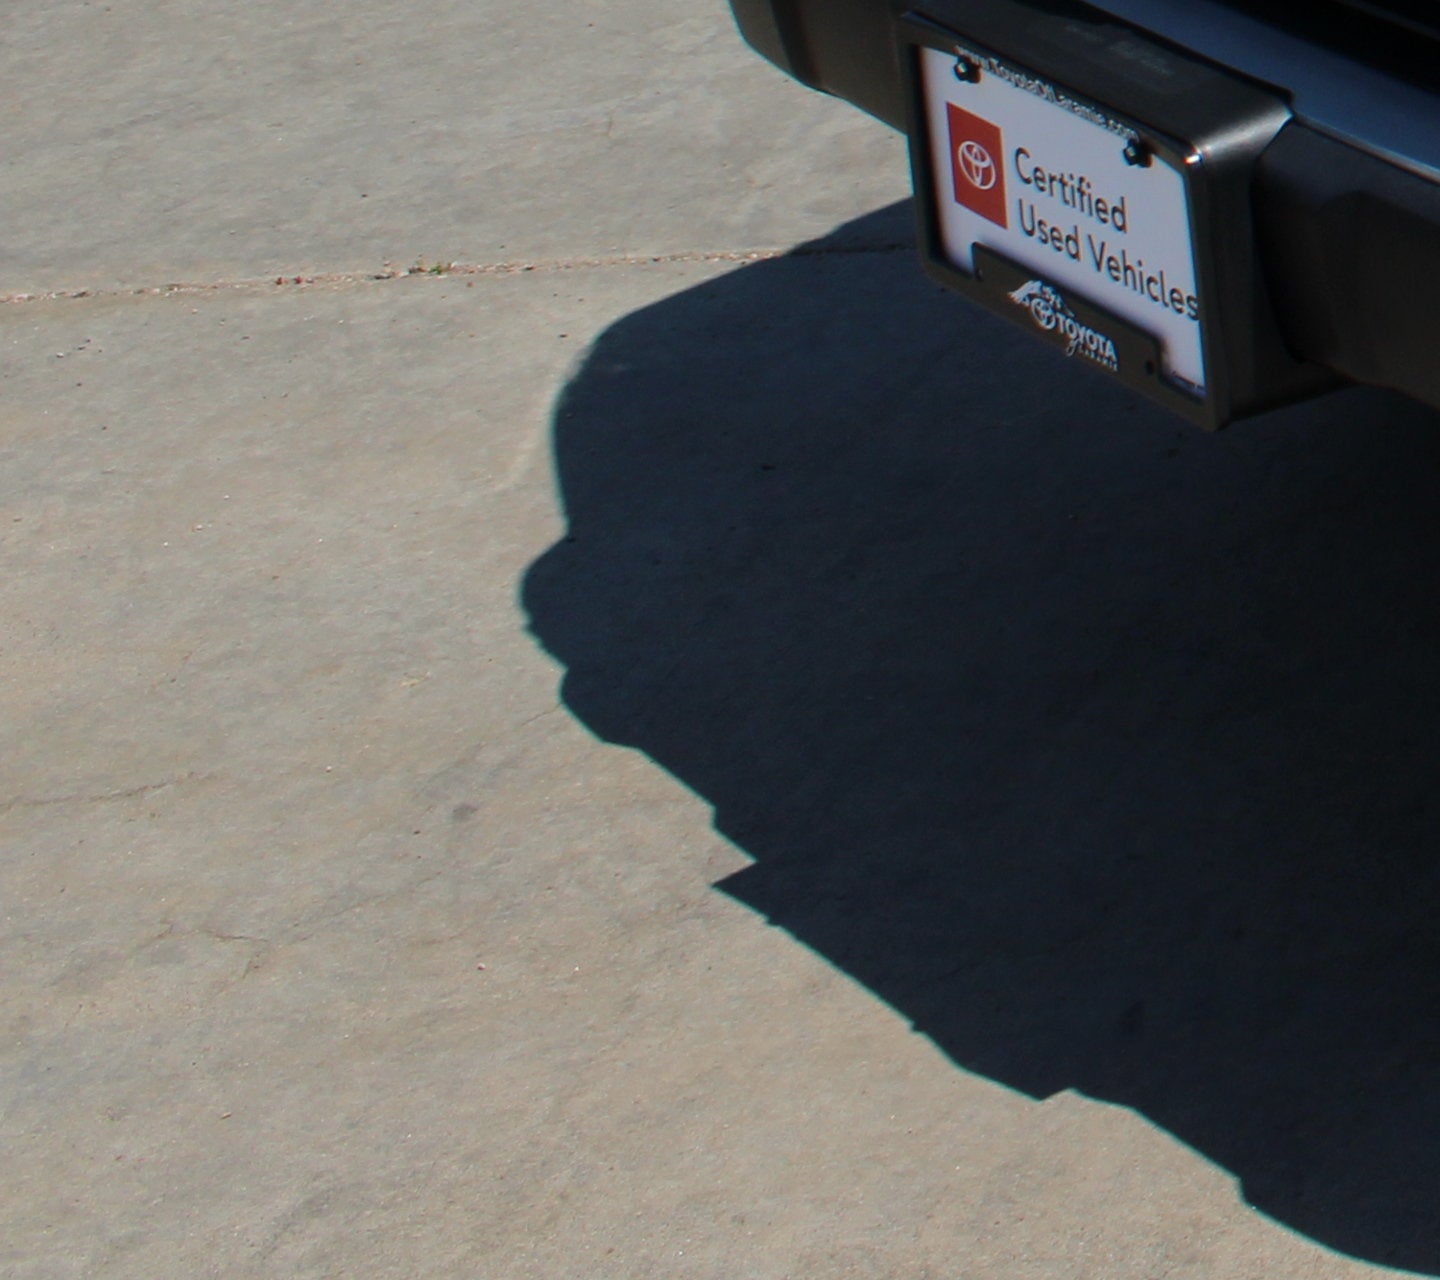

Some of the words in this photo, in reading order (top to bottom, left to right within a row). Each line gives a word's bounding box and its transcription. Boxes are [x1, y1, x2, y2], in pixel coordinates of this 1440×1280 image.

[1015, 147, 1127, 233] Certified
[1019, 198, 1080, 261] Used
[1088, 234, 1200, 321] Vehicles
[1055, 312, 1118, 365] TOYOTA
